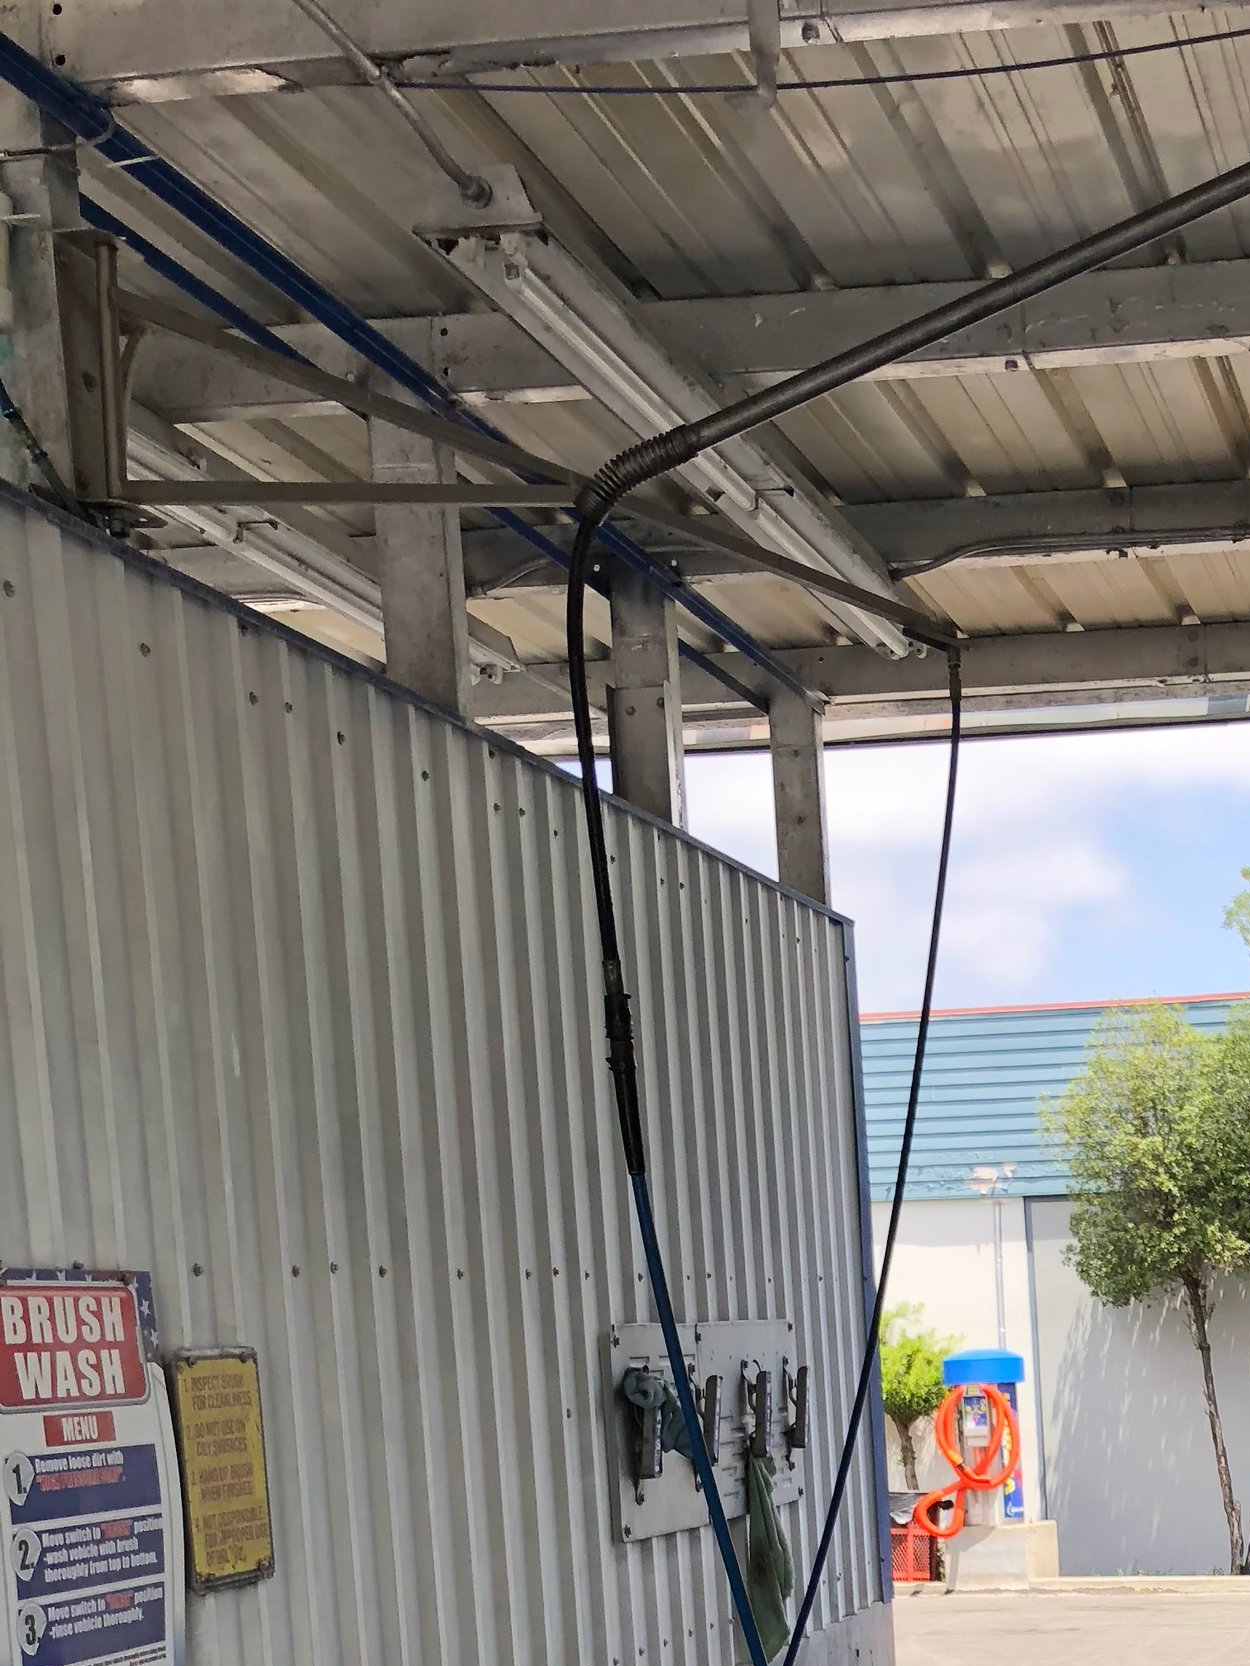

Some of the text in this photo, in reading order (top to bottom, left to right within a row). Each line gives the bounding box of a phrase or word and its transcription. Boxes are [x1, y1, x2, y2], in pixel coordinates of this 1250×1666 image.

[1, 1296, 125, 1344] BRUSH
[14, 1349, 126, 1400] WASH
[190, 1375, 219, 1392] INSPECT
[221, 1373, 244, 1389] BRUSH
[192, 1390, 252, 1411] FOR CLEANLINESS
[61, 1415, 99, 1441] MENU
[34, 1459, 68, 1473] Remove
[68, 1455, 91, 1469] loose
[92, 1452, 106, 1466] dirt
[106, 1450, 123, 1465] with
[42, 1533, 64, 1548] Move
[65, 1527, 92, 1544] switch
[92, 1527, 101, 1540] to
[133, 1516, 162, 1535] position
[69, 1543, 99, 1561] vehicle
[99, 1539, 116, 1556] with
[117, 1536, 139, 1553] brush
[44, 1562, 89, 1583] thoroughly
[90, 1559, 109, 1575] from
[108, 1557, 121, 1572] top
[122, 1555, 130, 1569] to
[48, 1606, 70, 1621] Move
[70, 1598, 97, 1617] switch
[97, 1598, 106, 1612] to
[134, 1587, 163, 1605] position
[73, 1615, 102, 1634] vehicle
